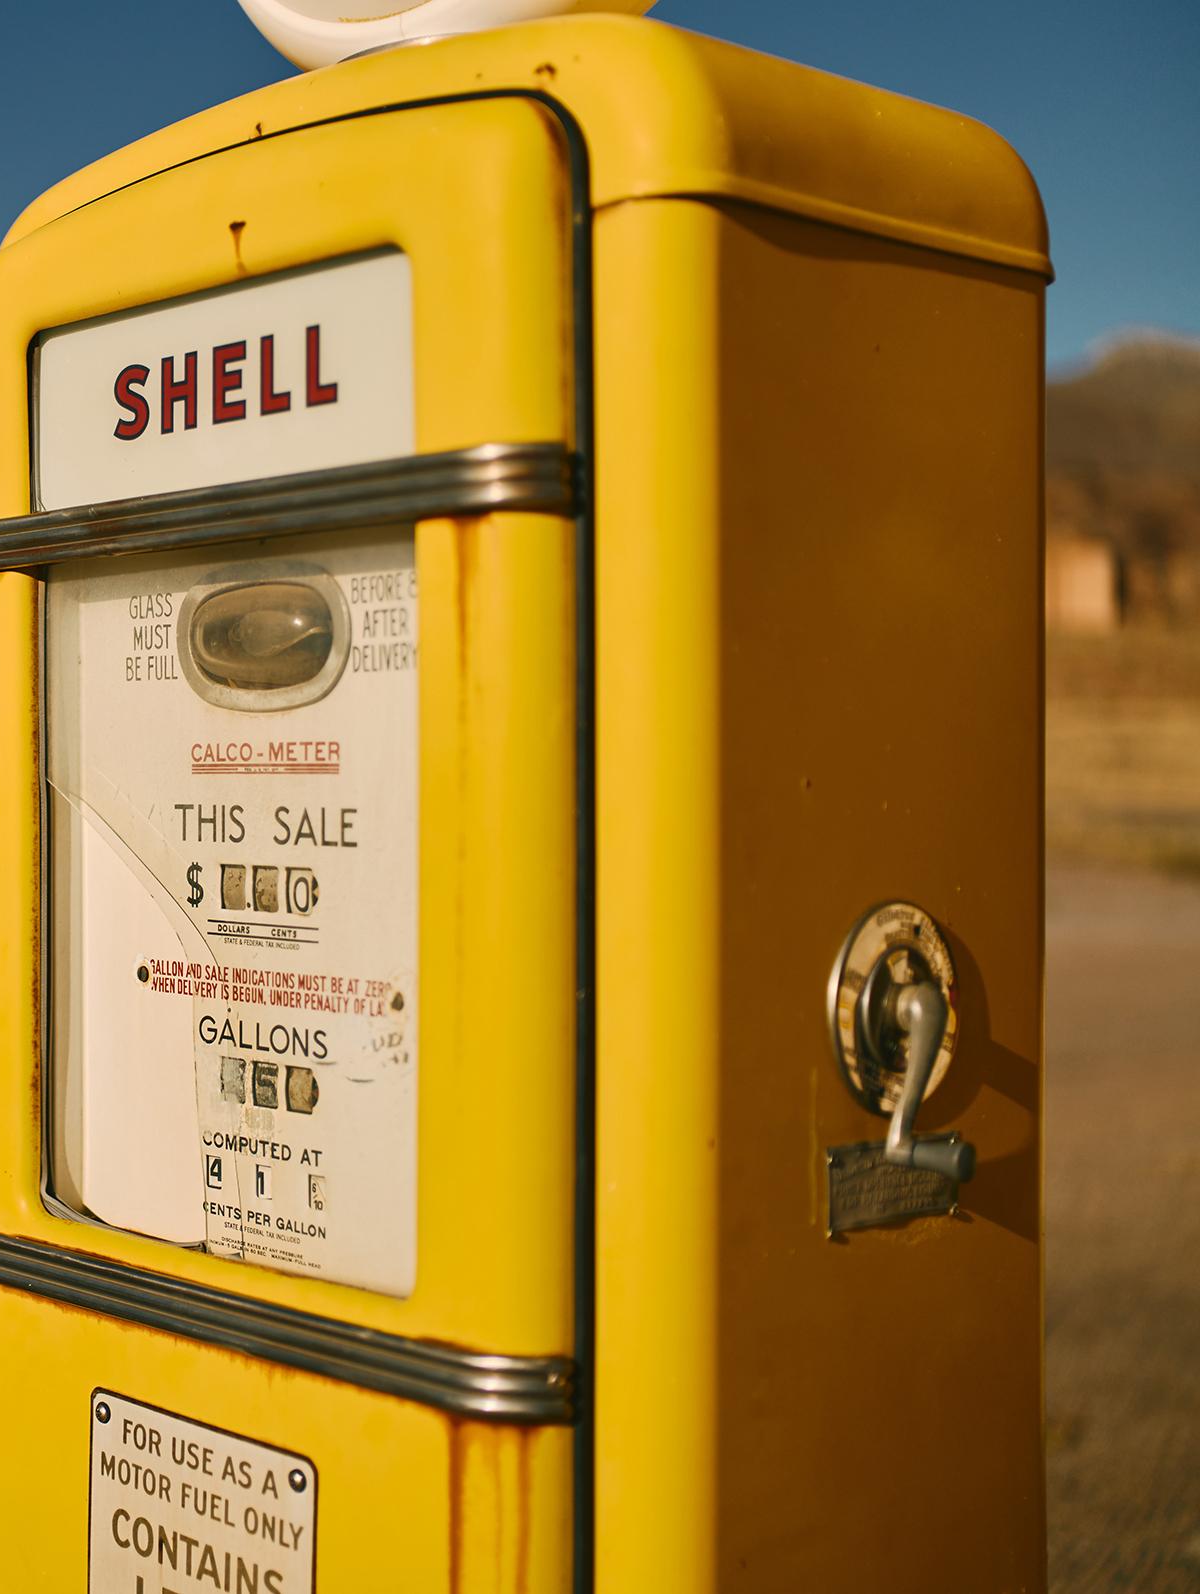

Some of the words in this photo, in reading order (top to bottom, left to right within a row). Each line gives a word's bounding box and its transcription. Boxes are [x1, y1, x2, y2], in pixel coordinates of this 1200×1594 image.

[113, 324, 338, 441] SHELL
[350, 572, 402, 604] BEFORE
[128, 593, 173, 620] GLASS
[362, 608, 410, 638] AFTER
[133, 624, 172, 651] MUST
[125, 656, 142, 682] BE
[147, 655, 178, 681] FULL
[174, 803, 246, 843] THIS
[273, 805, 358, 848] SALE
[186, 861, 204, 908] $
[217, 924, 250, 935] DOLLARS
[271, 929, 297, 938] CENTS
[275, 942, 300, 951] INCLUDED
[186, 963, 202, 979] AND
[205, 964, 229, 983] SALE
[232, 967, 295, 990] INDICATIONS
[298, 974, 326, 993] MUST
[330, 976, 343, 994] BE
[346, 979, 359, 996] AT
[221, 984, 229, 1000] IS
[270, 989, 302, 1009] UNDER
[304, 994, 349, 1013] PENALTY
[354, 998, 366, 1015] OF
[199, 1015, 328, 1059] GALLONS
[202, 1130, 291, 1161] COMPUTED
[300, 1149, 323, 1167] AT
[203, 1200, 241, 1220] CENTS
[247, 1210, 271, 1227] PER
[276, 1218, 327, 1239] GALLON
[224, 1221, 238, 1231] STATE
[244, 1226, 265, 1237] FEDERAL
[266, 1230, 275, 1239] TAX
[122, 1418, 161, 1457] FOR
[171, 1436, 214, 1476] USE
[221, 1456, 252, 1489] AS
[261, 1470, 279, 1499] A
[100, 1451, 171, 1503] MOTOR
[181, 1482, 236, 1528] FUEL
[244, 1507, 304, 1551] ONLY
[112, 1508, 284, 1594] CONTAINS
